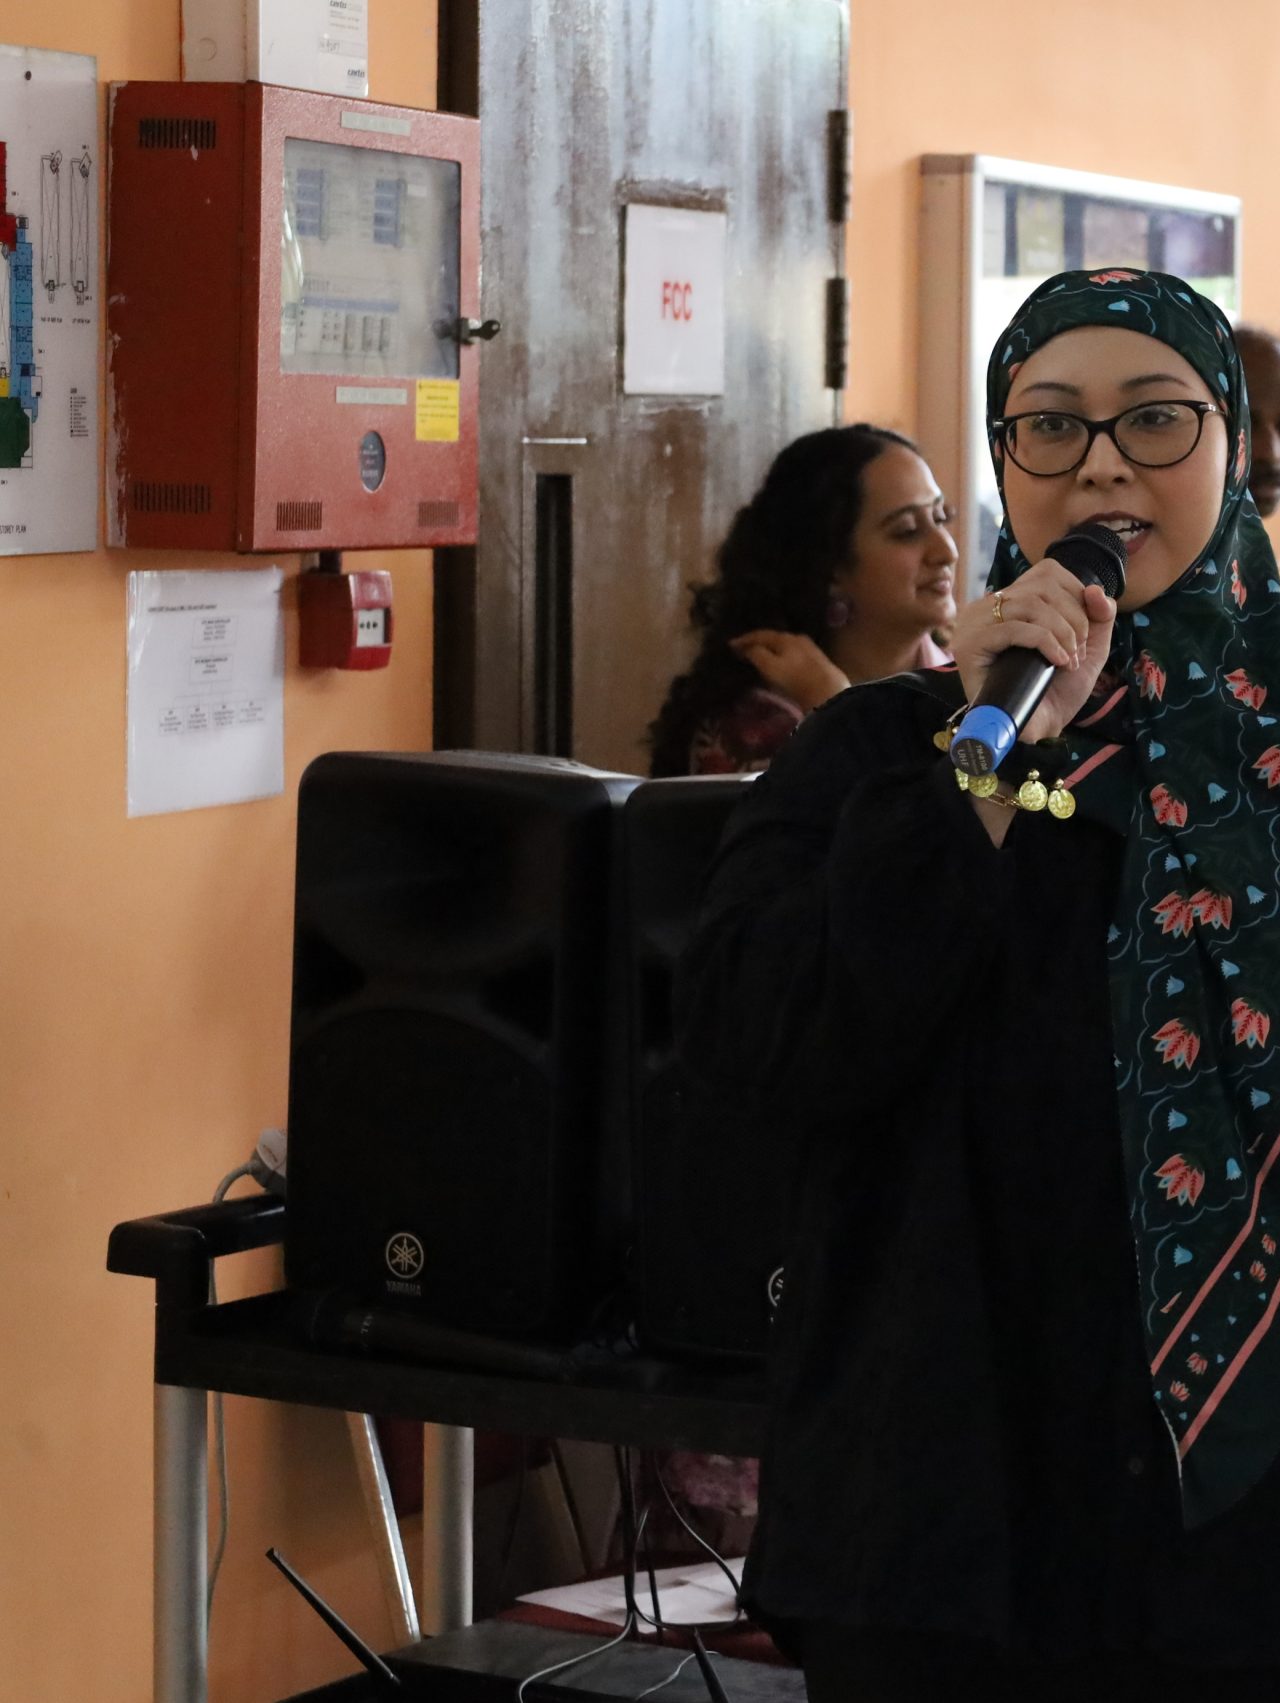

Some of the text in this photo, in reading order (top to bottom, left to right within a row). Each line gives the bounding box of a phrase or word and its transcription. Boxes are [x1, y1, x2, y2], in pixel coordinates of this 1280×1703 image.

[662, 281, 692, 321] FCC
[15, 525, 26, 534] PLAN
[957, 748, 968, 765] UHF
[385, 1280, 422, 1297] YAMAHA
